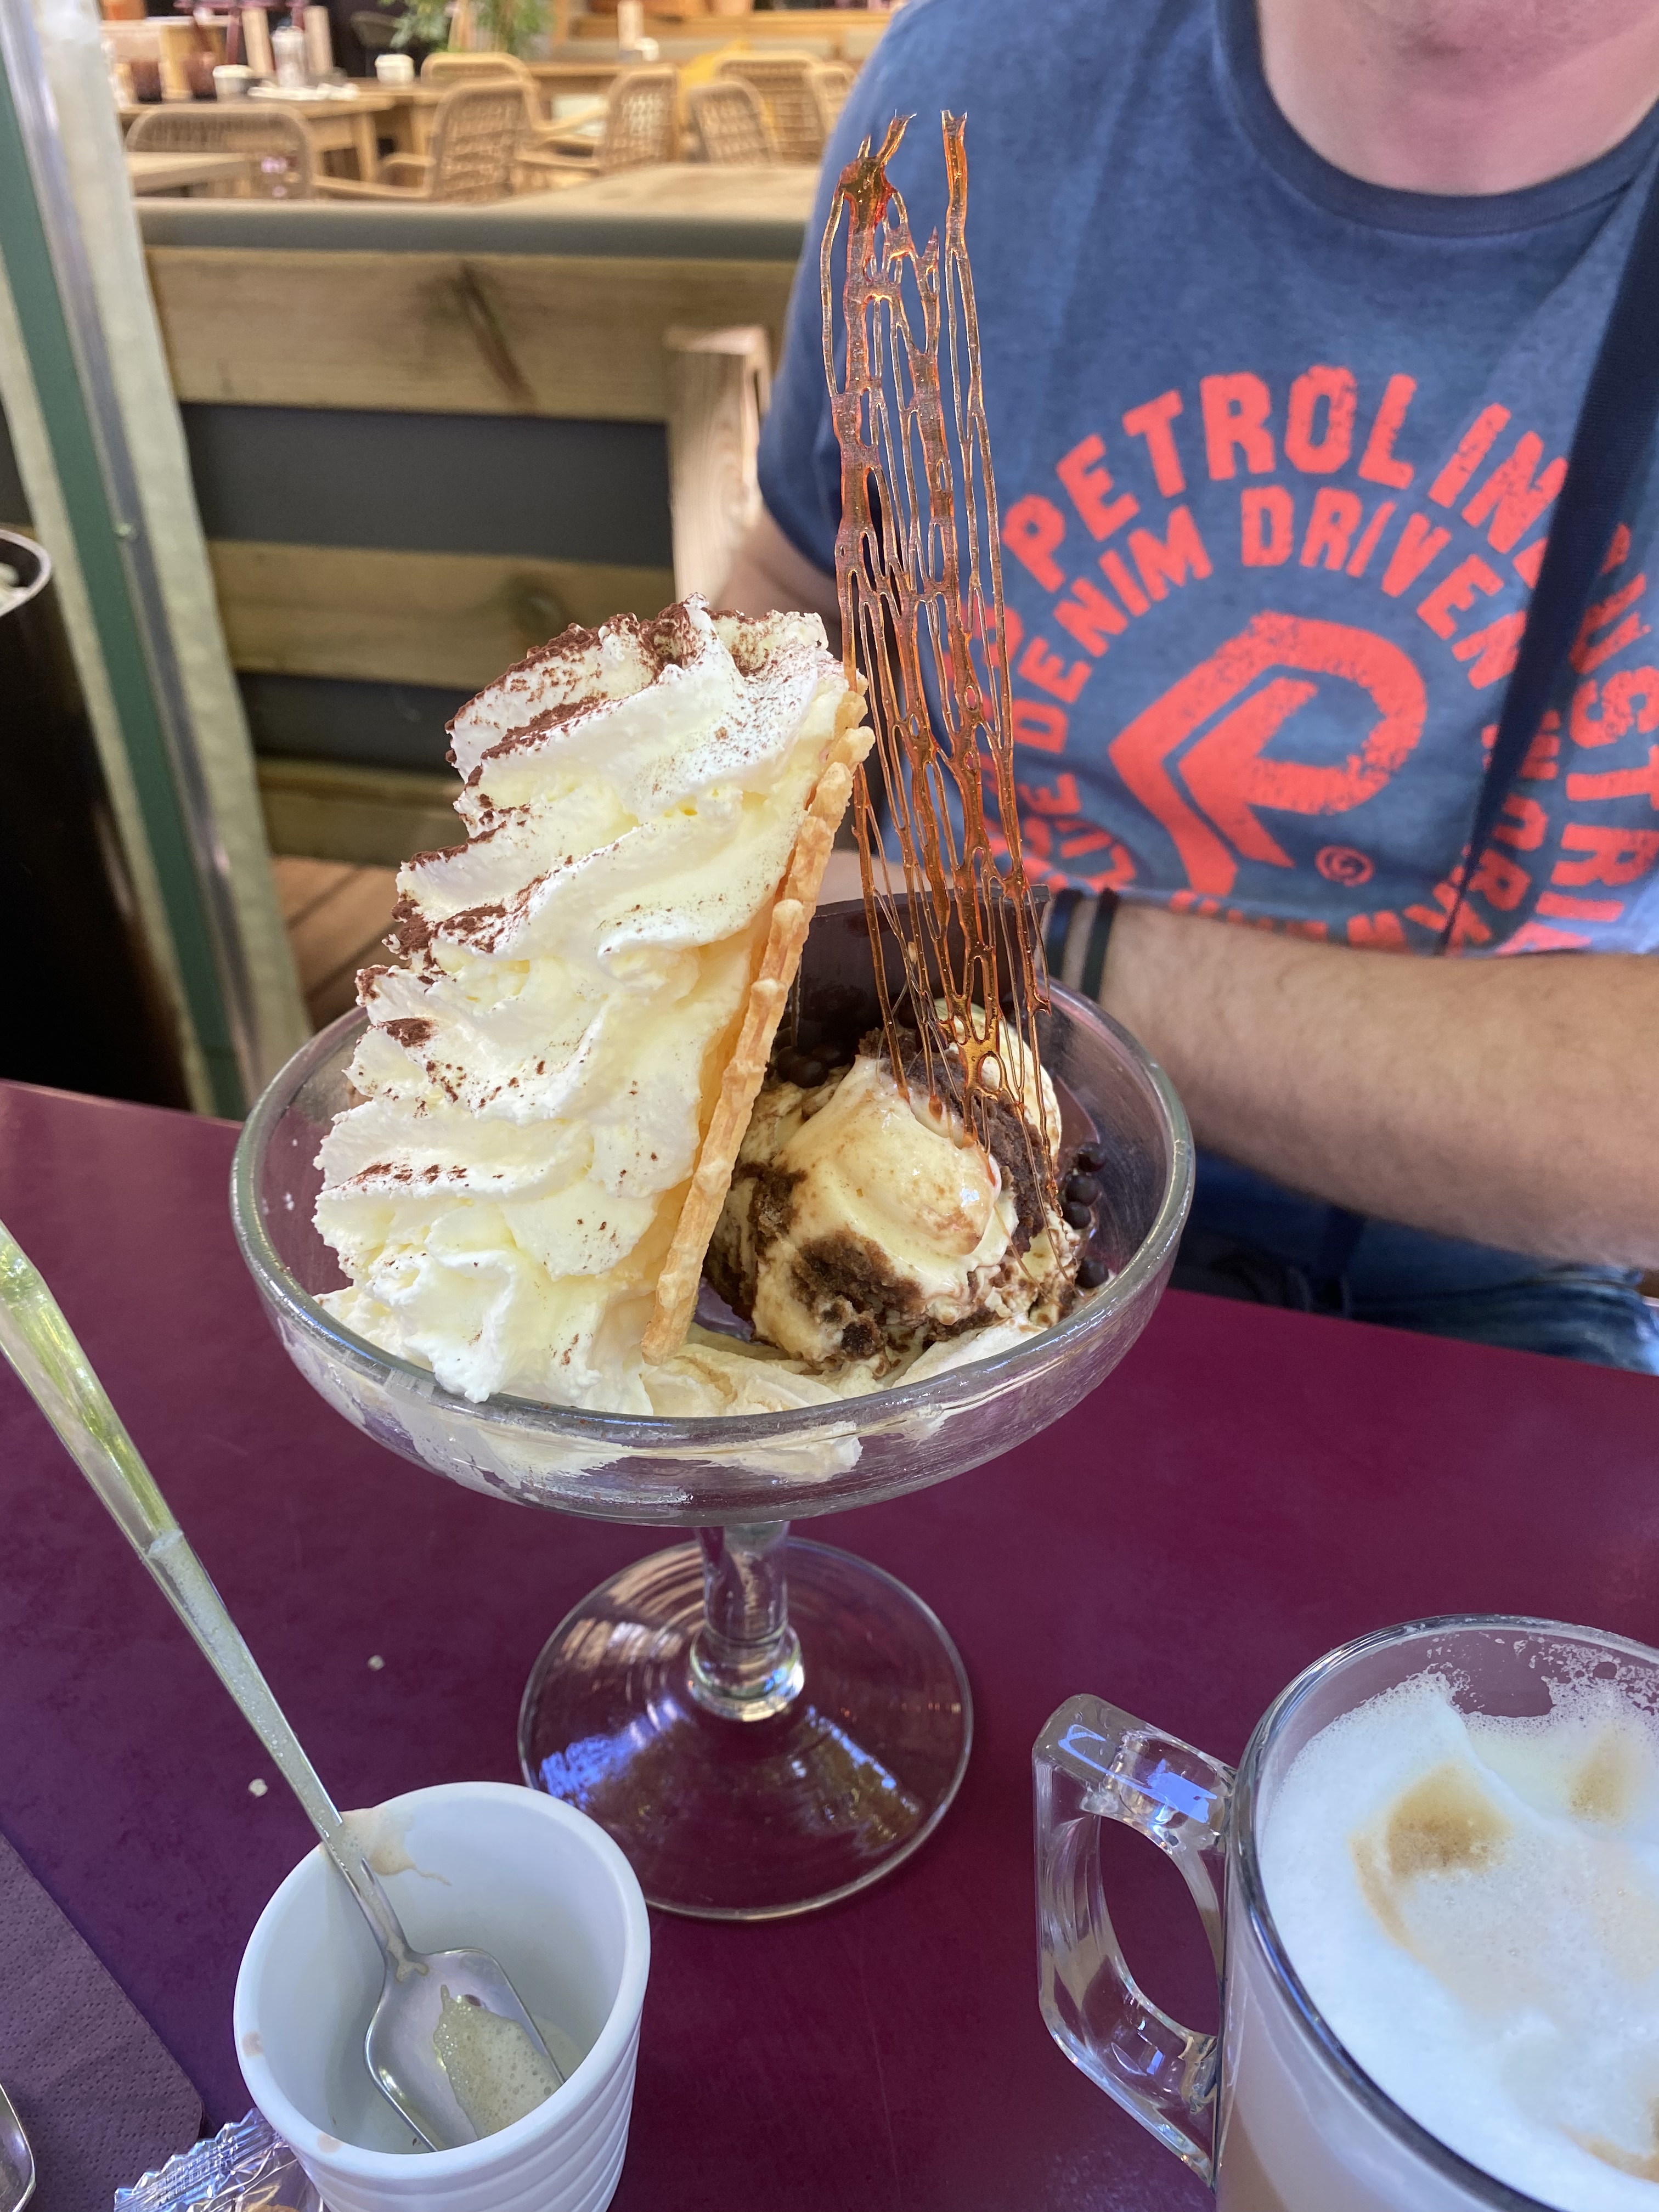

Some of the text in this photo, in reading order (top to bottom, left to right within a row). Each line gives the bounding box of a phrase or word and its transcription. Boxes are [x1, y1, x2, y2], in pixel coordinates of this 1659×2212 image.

[1000, 365, 1416, 592] PETROL
[1429, 404, 1659, 956] INUSTRI
[1011, 506, 1212, 754] DENIM
[1241, 485, 1528, 689] DRIVEN
